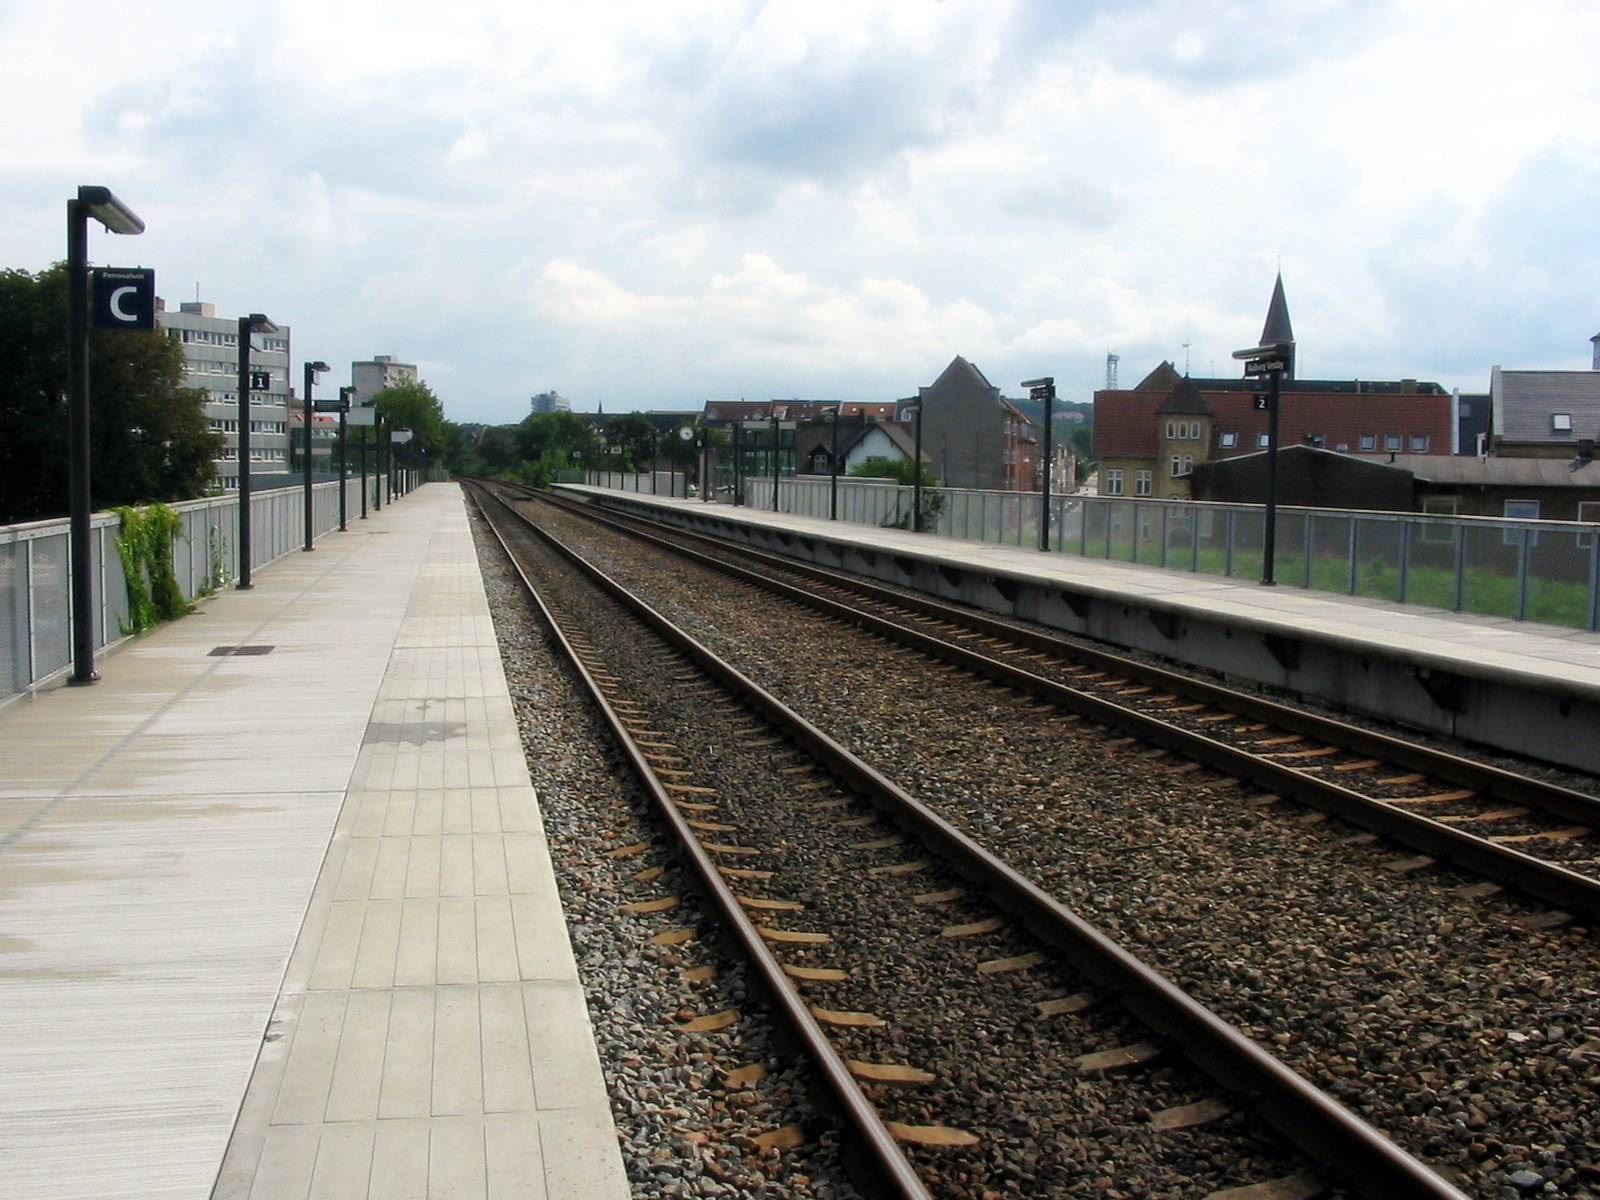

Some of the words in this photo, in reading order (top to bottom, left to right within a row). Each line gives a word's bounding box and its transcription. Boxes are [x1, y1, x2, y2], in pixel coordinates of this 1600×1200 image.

[110, 286, 137, 322] C
[258, 378, 264, 388] 1
[1259, 399, 1265, 408] 2
